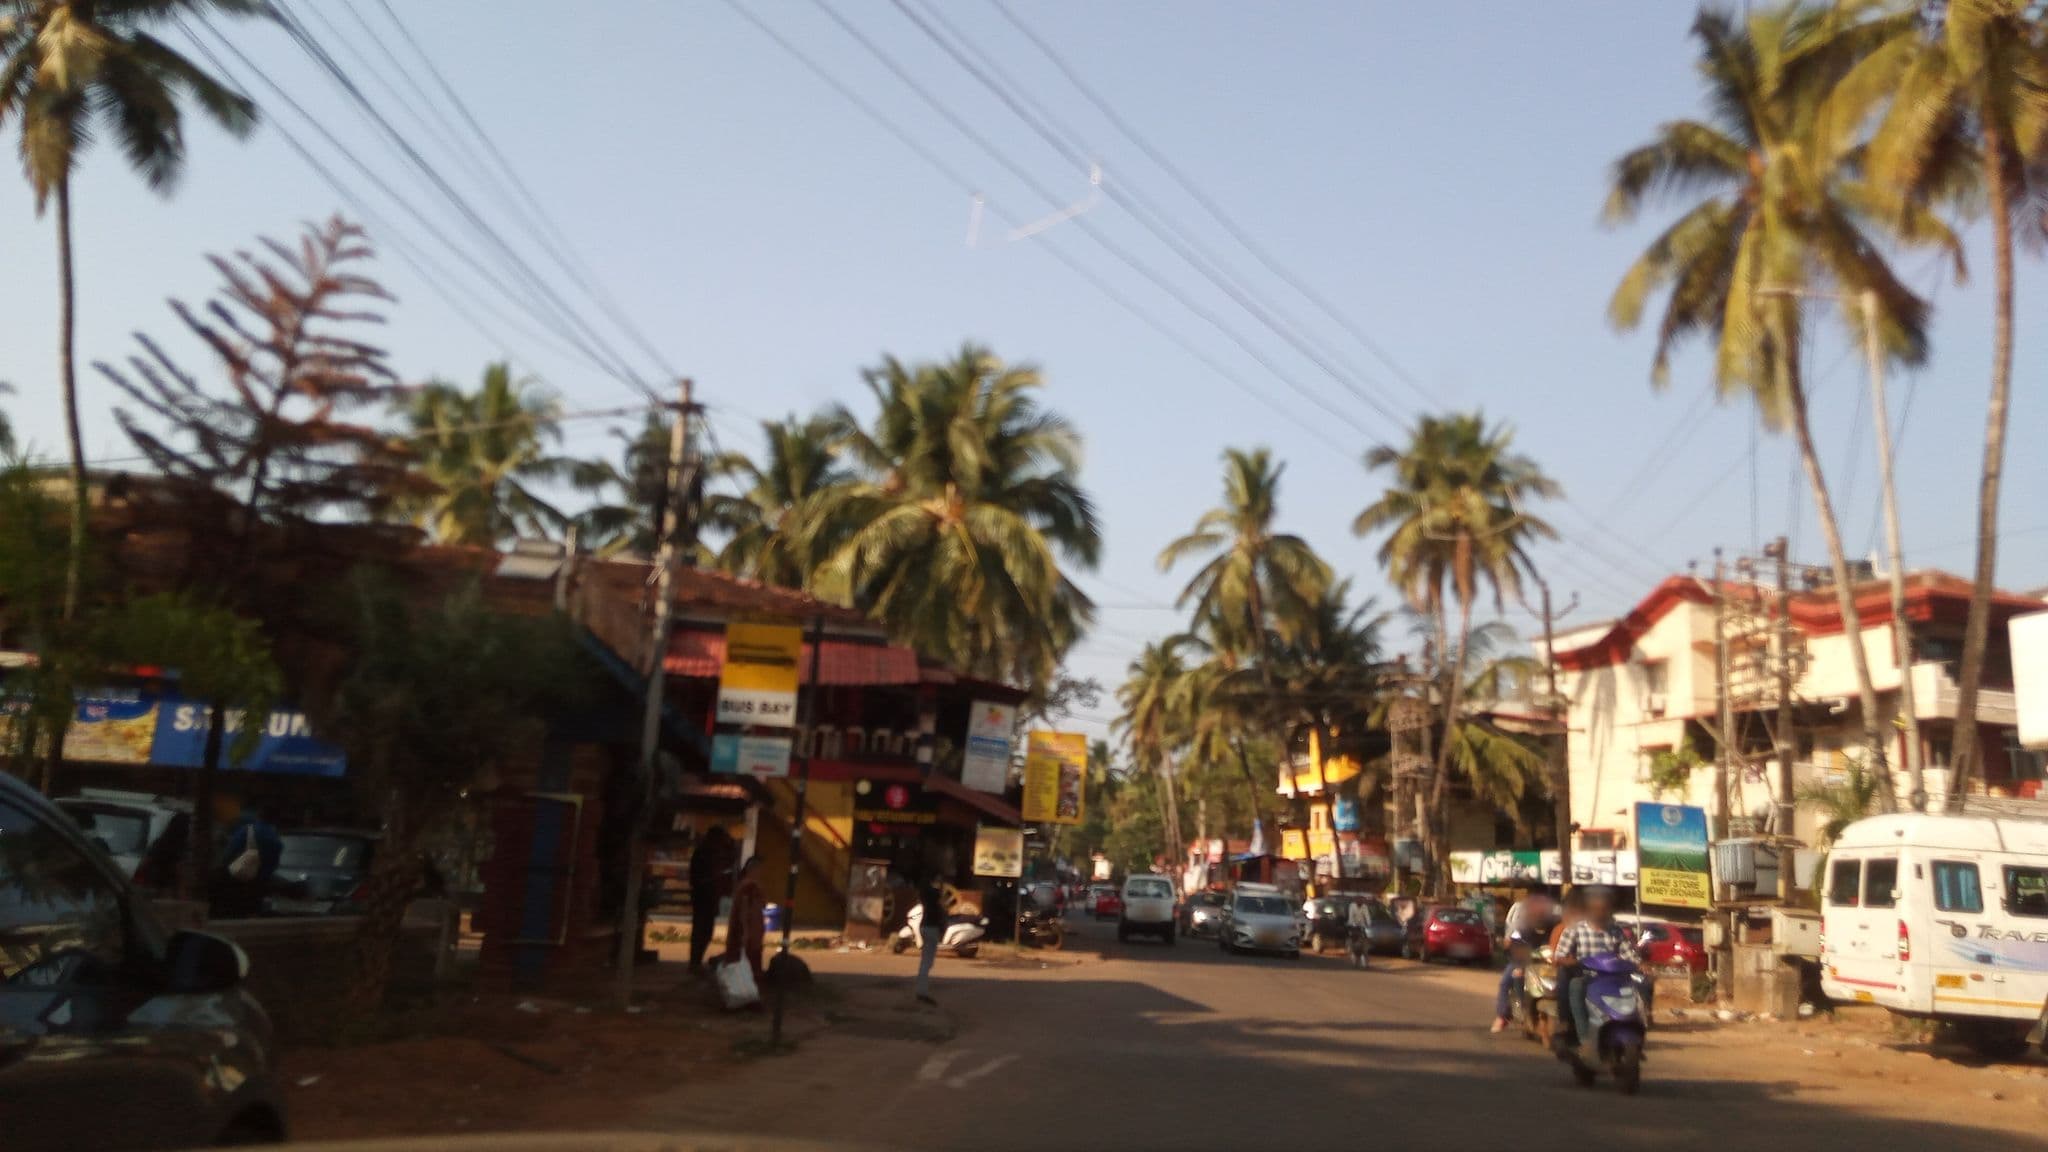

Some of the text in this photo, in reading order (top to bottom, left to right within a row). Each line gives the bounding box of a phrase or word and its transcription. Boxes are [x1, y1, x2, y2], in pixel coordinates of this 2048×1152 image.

[721, 701, 793, 715] BUS BAY
[1672, 880, 1700, 889] STORE
